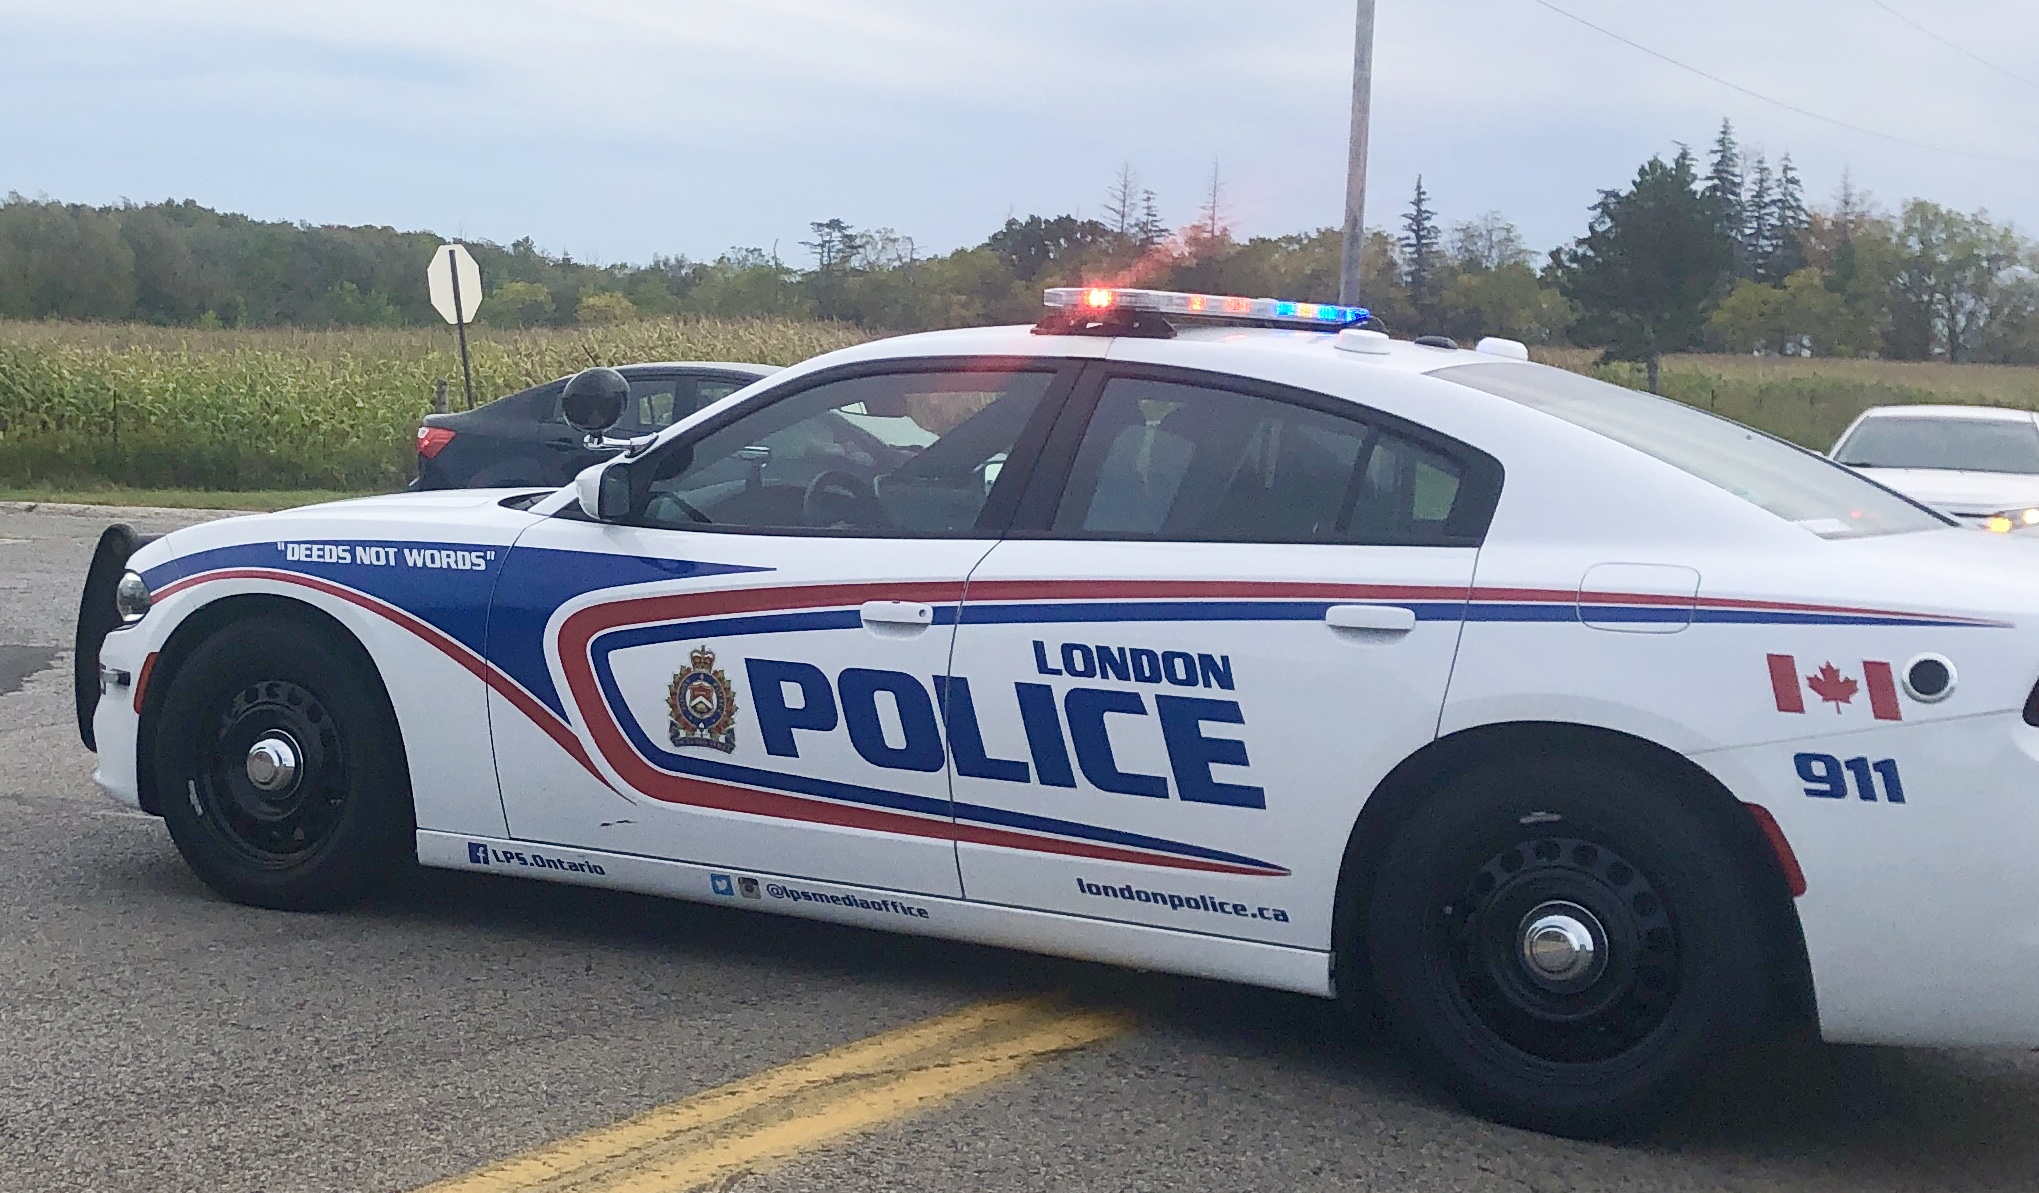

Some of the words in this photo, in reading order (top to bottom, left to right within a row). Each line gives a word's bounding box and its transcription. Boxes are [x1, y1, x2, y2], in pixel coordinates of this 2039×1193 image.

[277, 541, 351, 564] "DEEDS
[355, 546, 398, 567] NOT
[403, 548, 496, 571] WORDS"
[1032, 639, 1236, 691] LONDON
[744, 657, 1267, 810] POLICE
[1793, 752, 1907, 805] 911
[491, 848, 606, 876] LPS.Ontario
[766, 883, 930, 919] @lpsmediaoffice
[1076, 877, 1290, 923] londonpolice.ca
